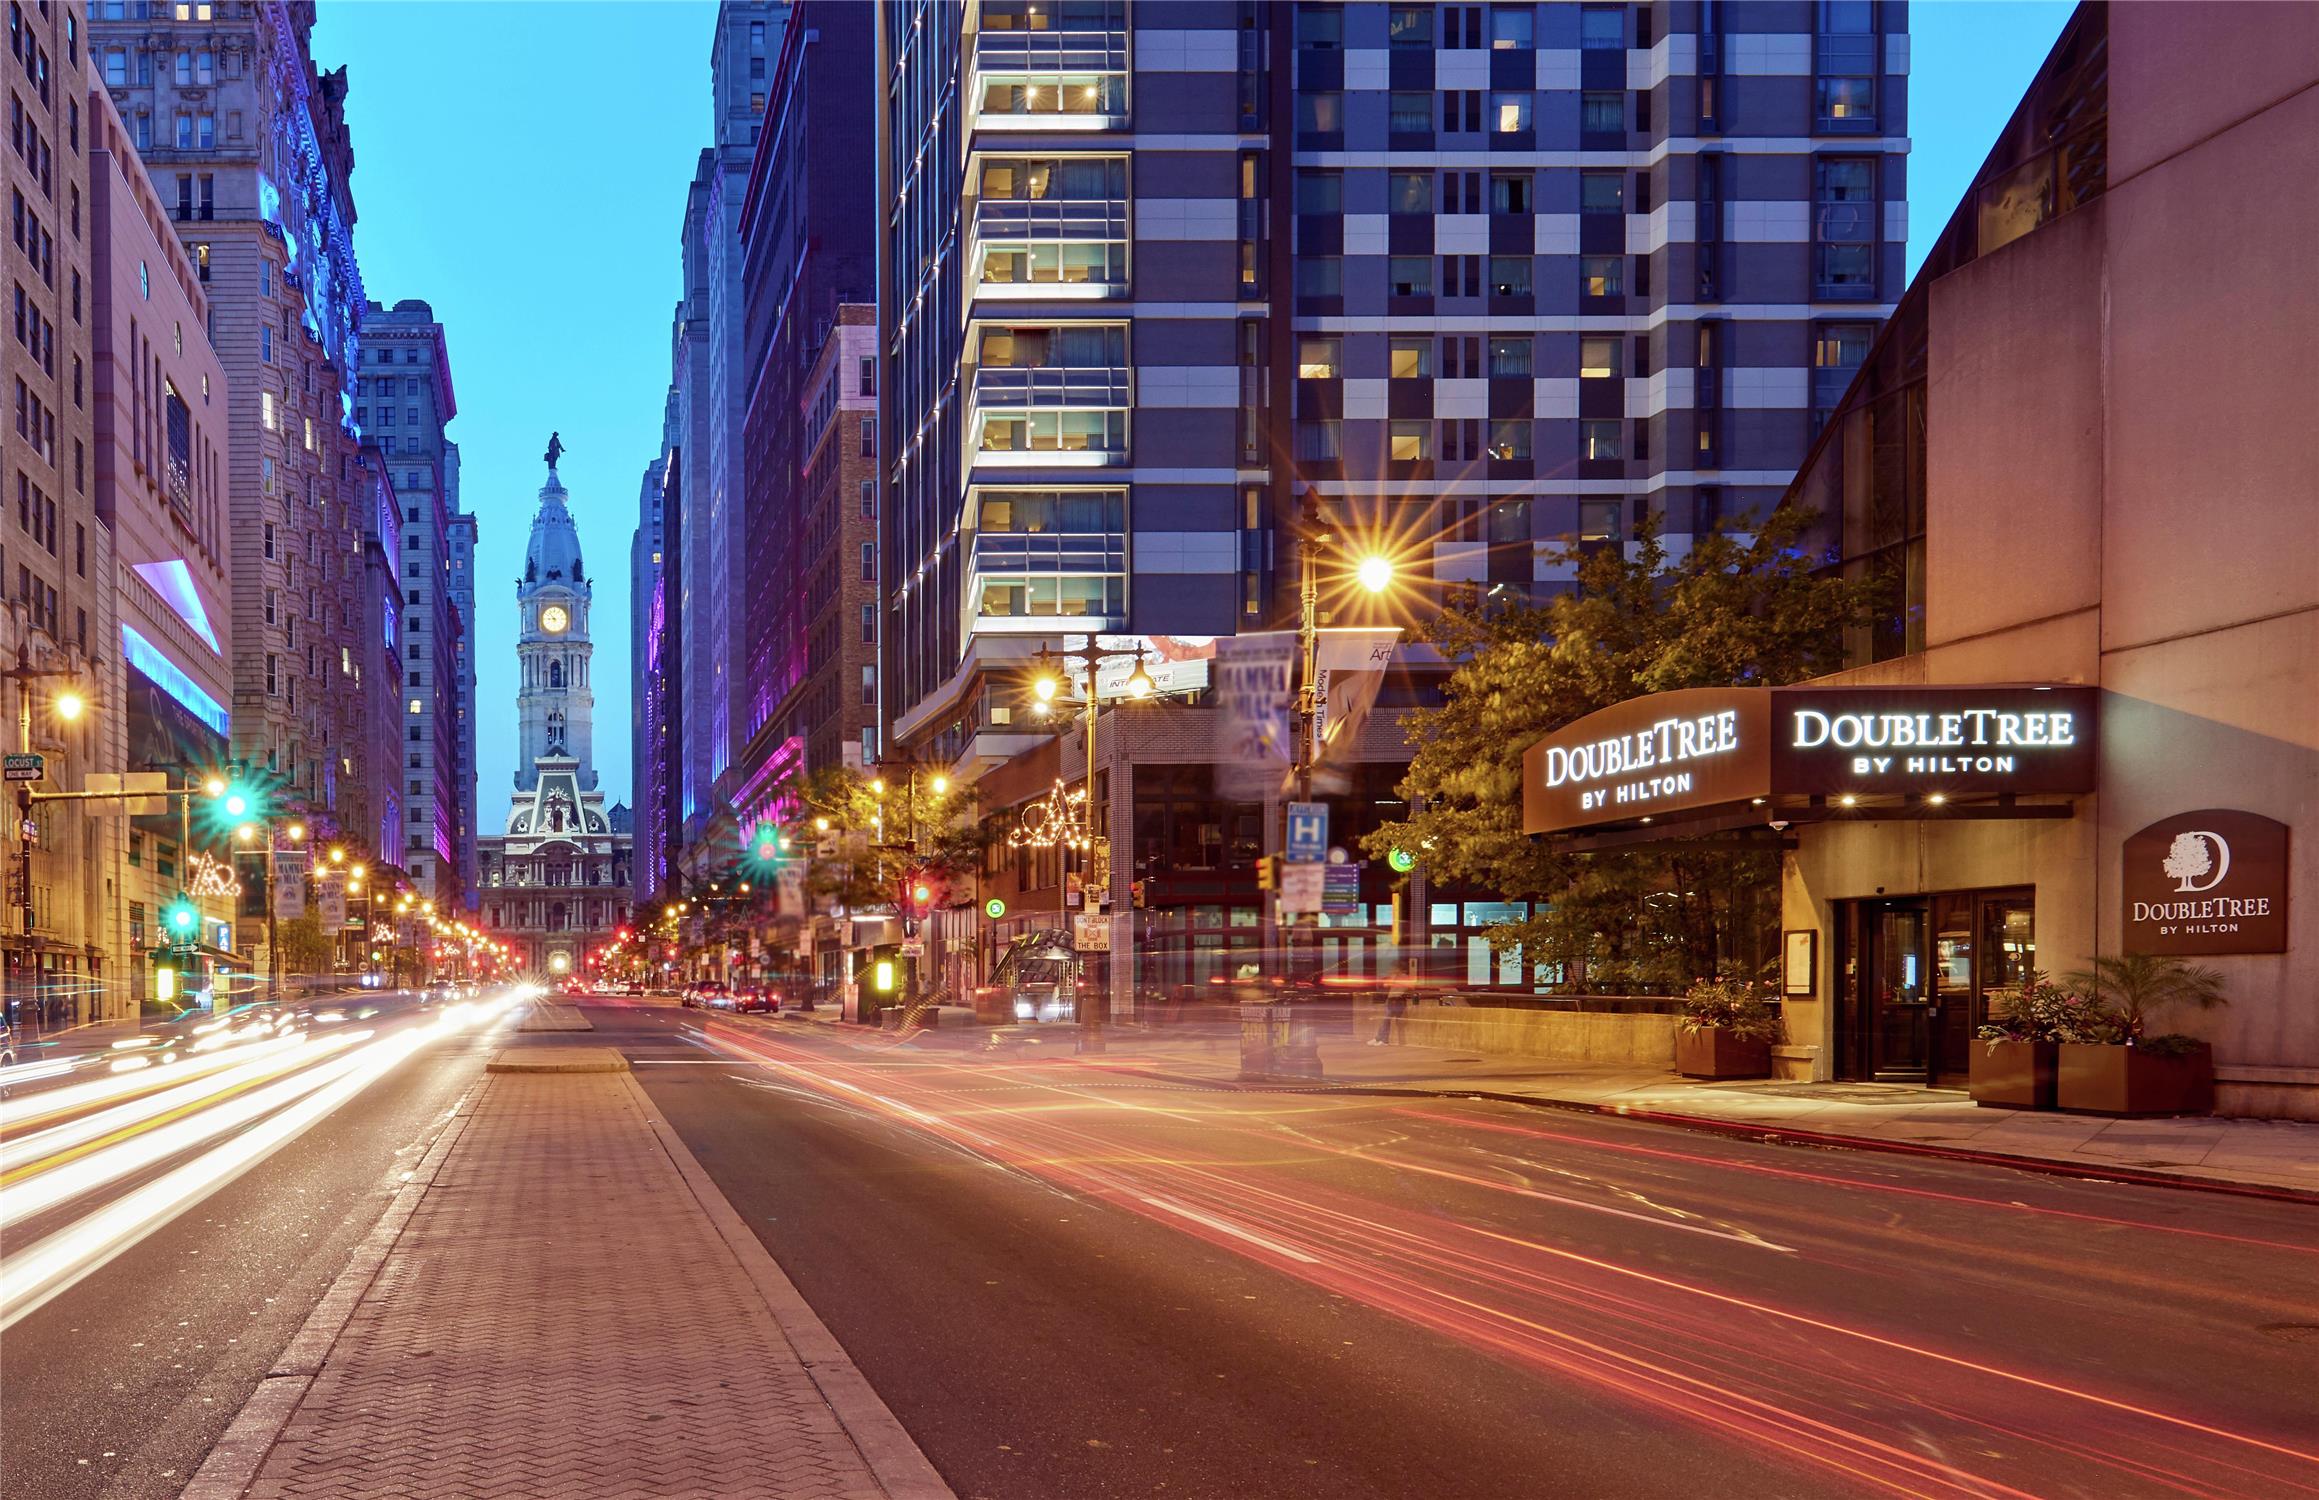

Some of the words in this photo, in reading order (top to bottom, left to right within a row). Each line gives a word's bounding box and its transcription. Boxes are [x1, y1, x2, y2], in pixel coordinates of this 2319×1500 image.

[1316, 710, 1325, 738] Times
[1793, 709, 2074, 747] DOUBLETREE
[1546, 711, 1738, 787] DOUBLETREE
[4, 758, 34, 768] LOCUST
[1854, 757, 1891, 773] BY
[1907, 756, 2013, 773] HILTON
[1582, 789, 1606, 810] BY
[1616, 773, 1690, 803] HILTON
[1295, 816, 1320, 842] H
[2132, 897, 2270, 921] DOUBLETREE
[2160, 926, 2178, 935] BY
[2186, 923, 2239, 934] HILTON
[1094, 942, 1108, 950] BOX
